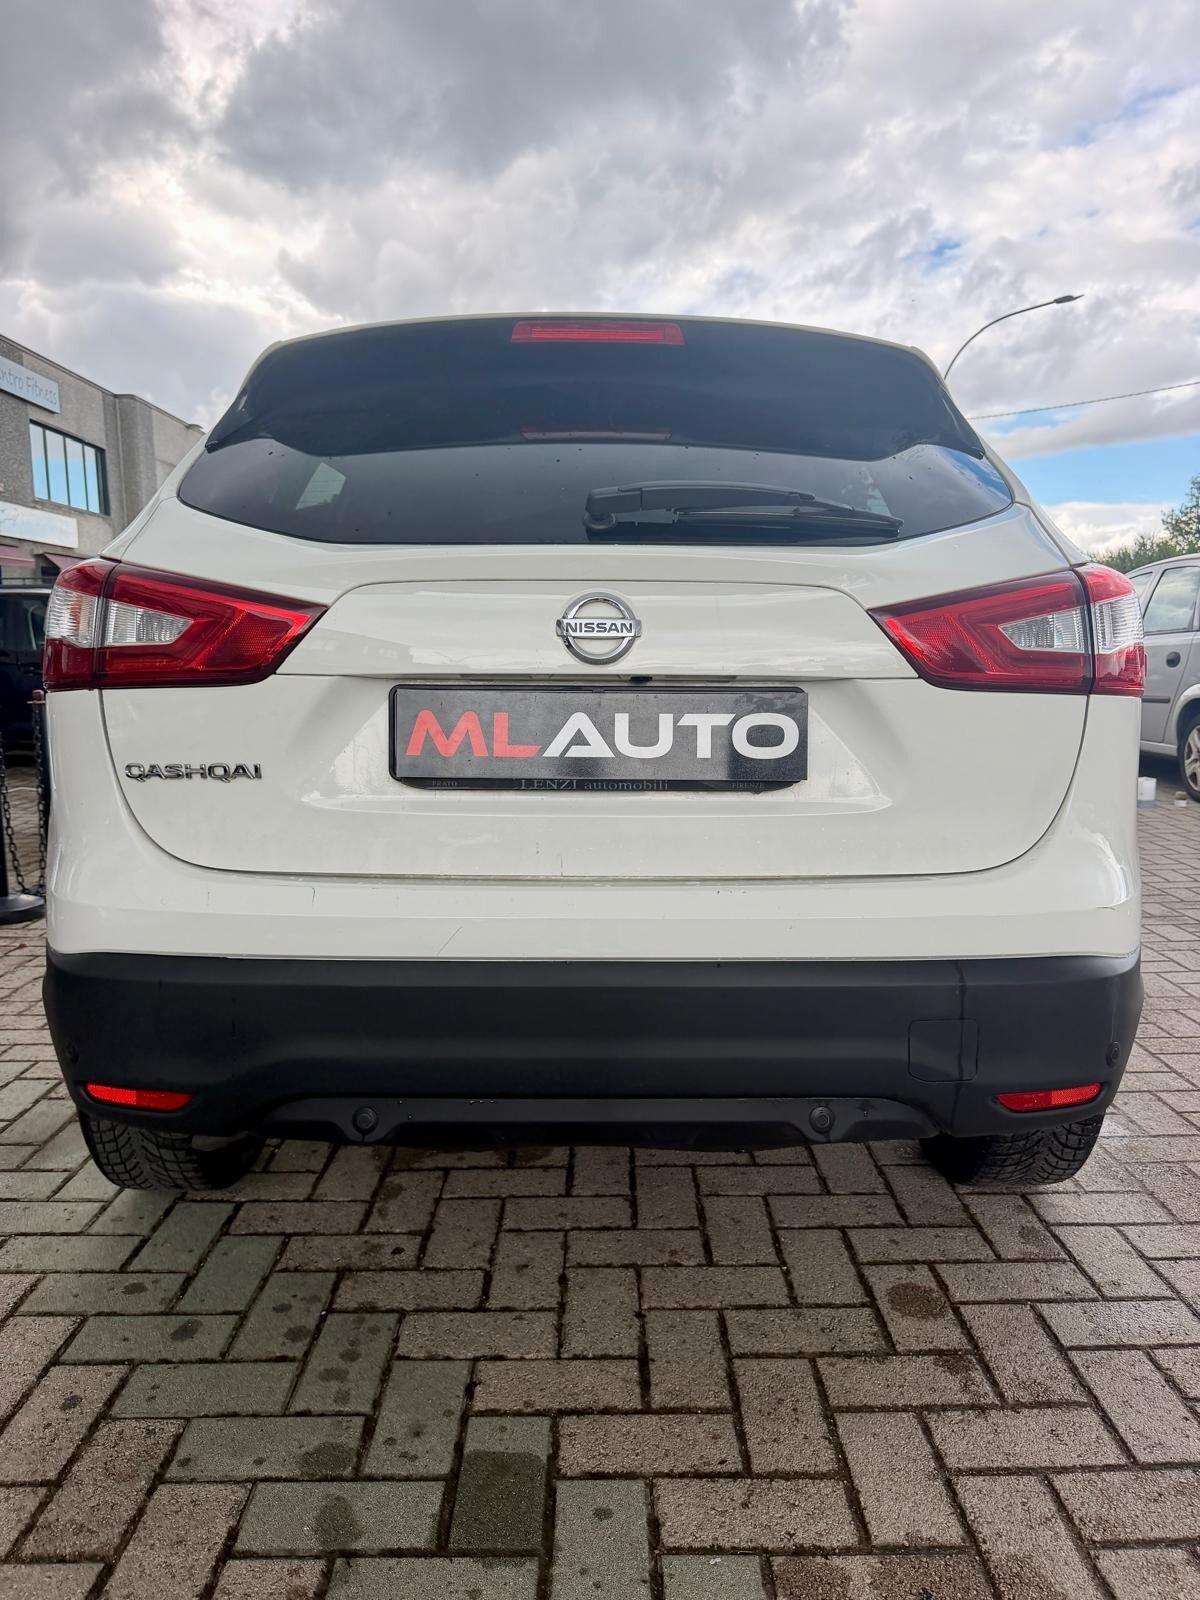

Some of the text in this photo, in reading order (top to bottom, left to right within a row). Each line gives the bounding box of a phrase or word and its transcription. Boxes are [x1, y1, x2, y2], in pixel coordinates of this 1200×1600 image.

[565, 622, 633, 633] NISSAN
[124, 763, 263, 783] QASHQAI
[521, 779, 669, 790] LENZI automobili
